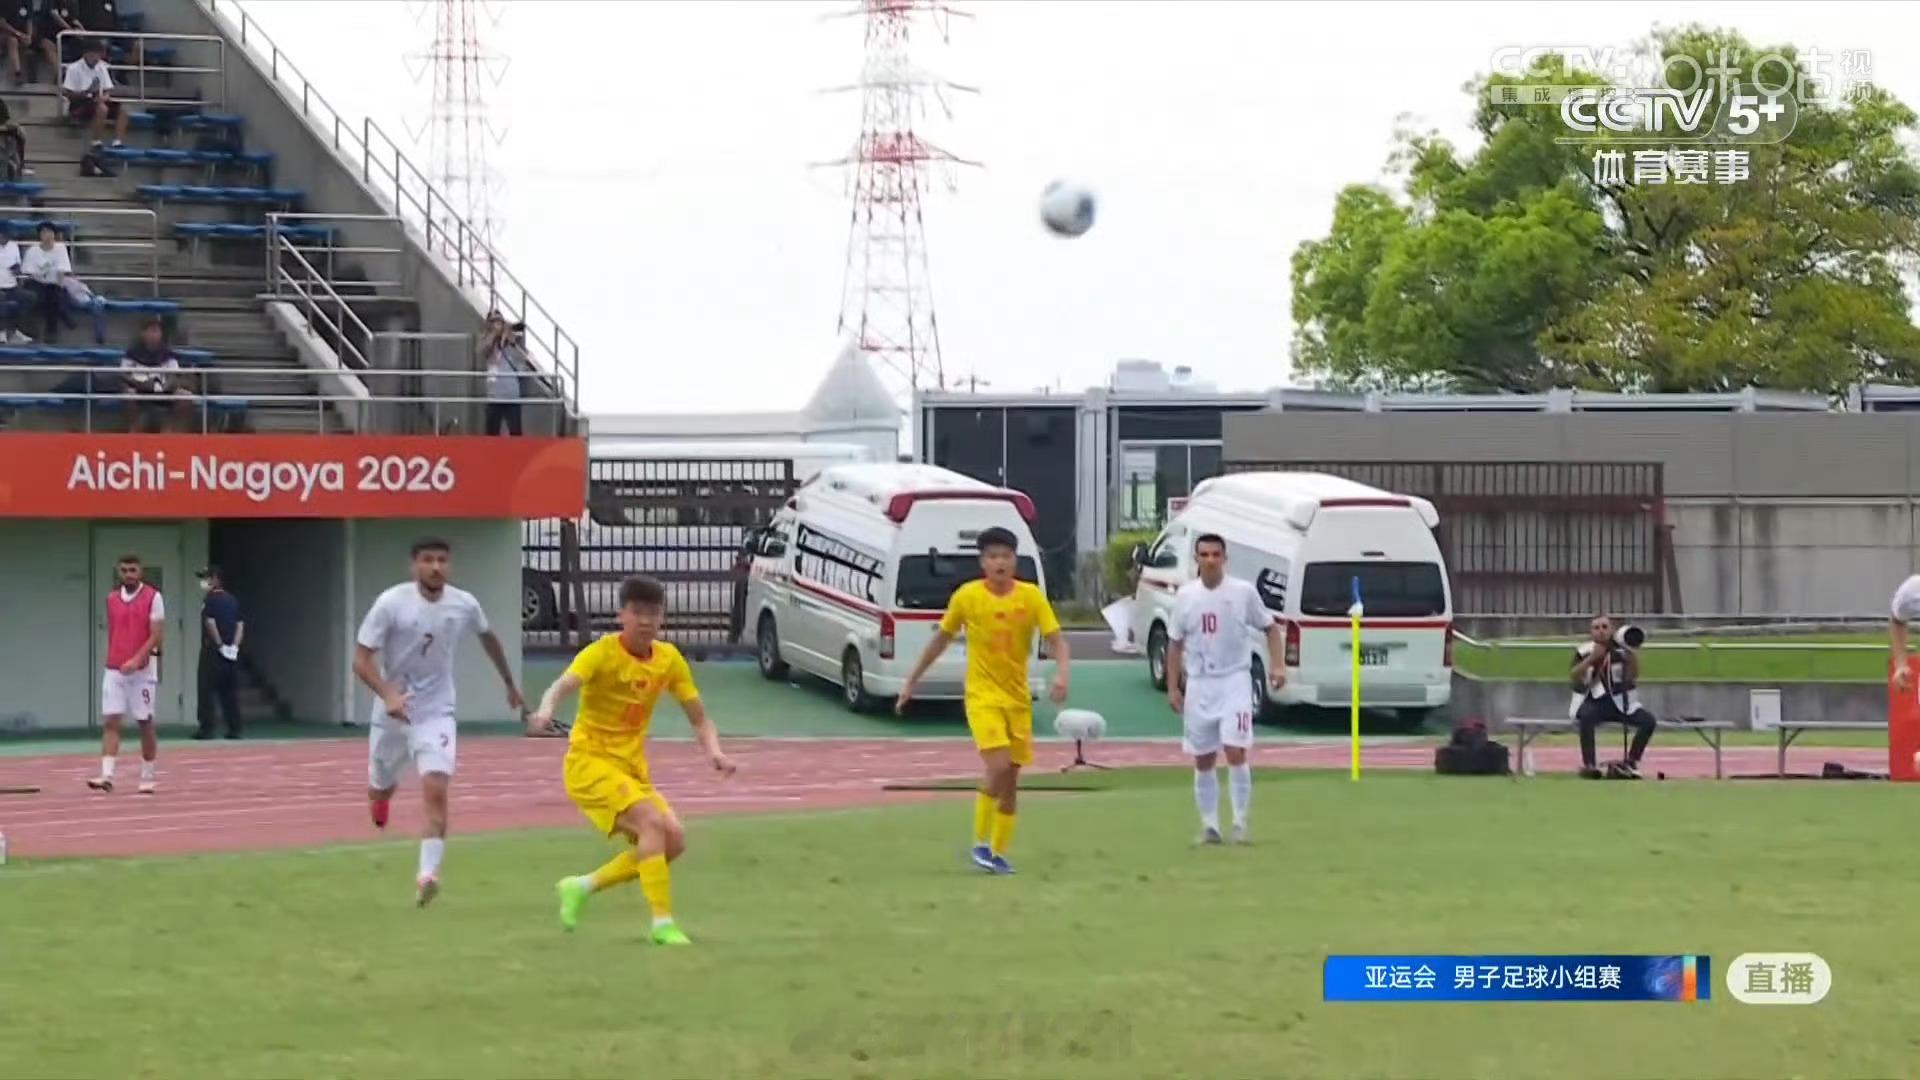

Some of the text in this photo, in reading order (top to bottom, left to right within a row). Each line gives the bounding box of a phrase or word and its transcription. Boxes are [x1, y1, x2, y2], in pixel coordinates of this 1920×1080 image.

[66, 451, 456, 501] Aichi-Nagoya 2026
[1202, 613, 1217, 634] 10
[422, 632, 434, 657] 7
[142, 688, 150, 705] 9
[1236, 712, 1250, 732] 10
